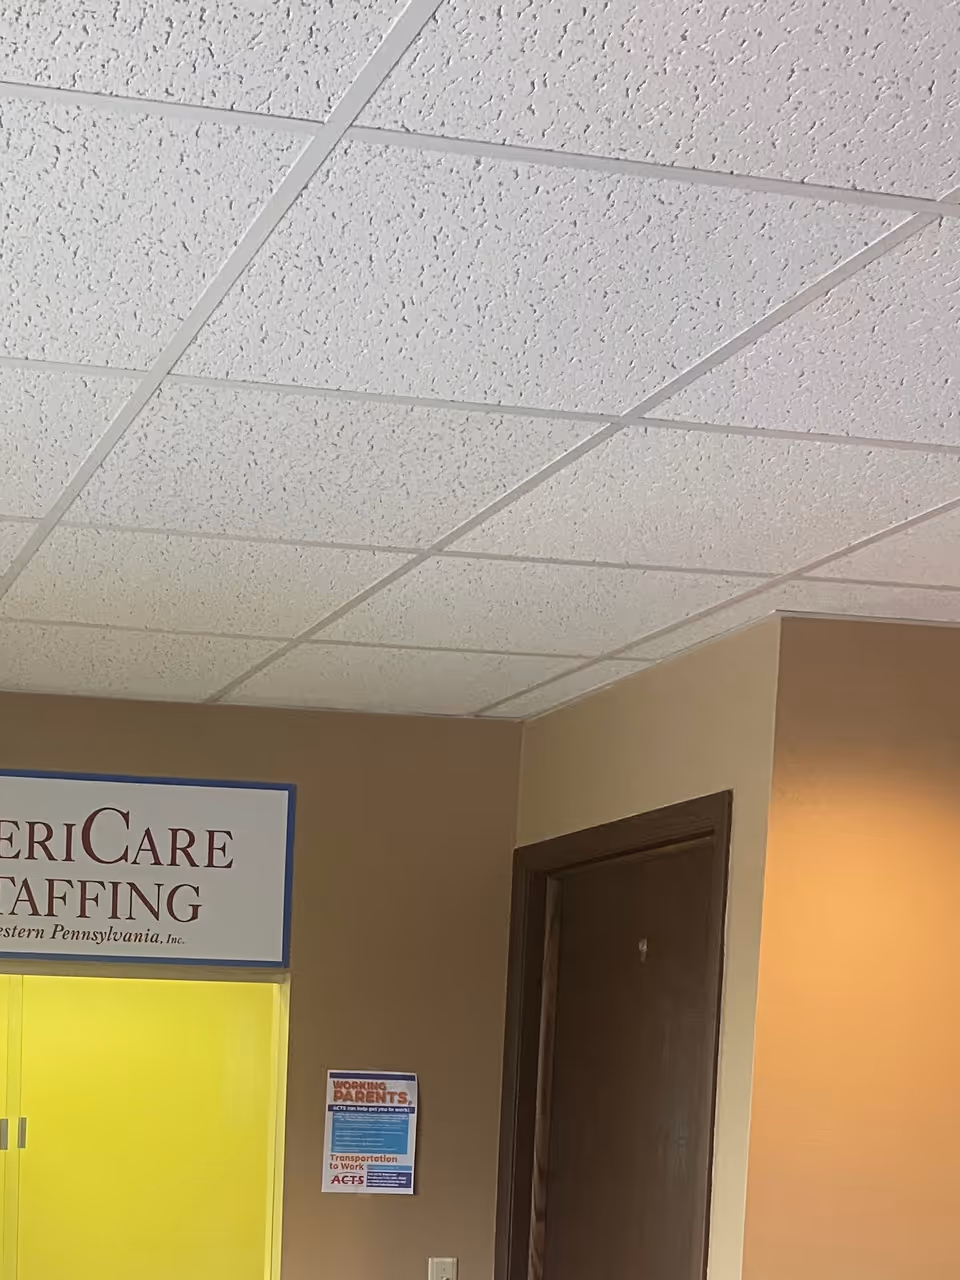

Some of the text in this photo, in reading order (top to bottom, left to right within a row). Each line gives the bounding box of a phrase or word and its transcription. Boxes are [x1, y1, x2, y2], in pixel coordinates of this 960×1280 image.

[166, 933, 185, 945] Inc.
[333, 1081, 387, 1091] WORKING
[330, 1154, 398, 1163] Transportation
[340, 1162, 364, 1171] Work
[331, 1175, 364, 1185] ACTS
